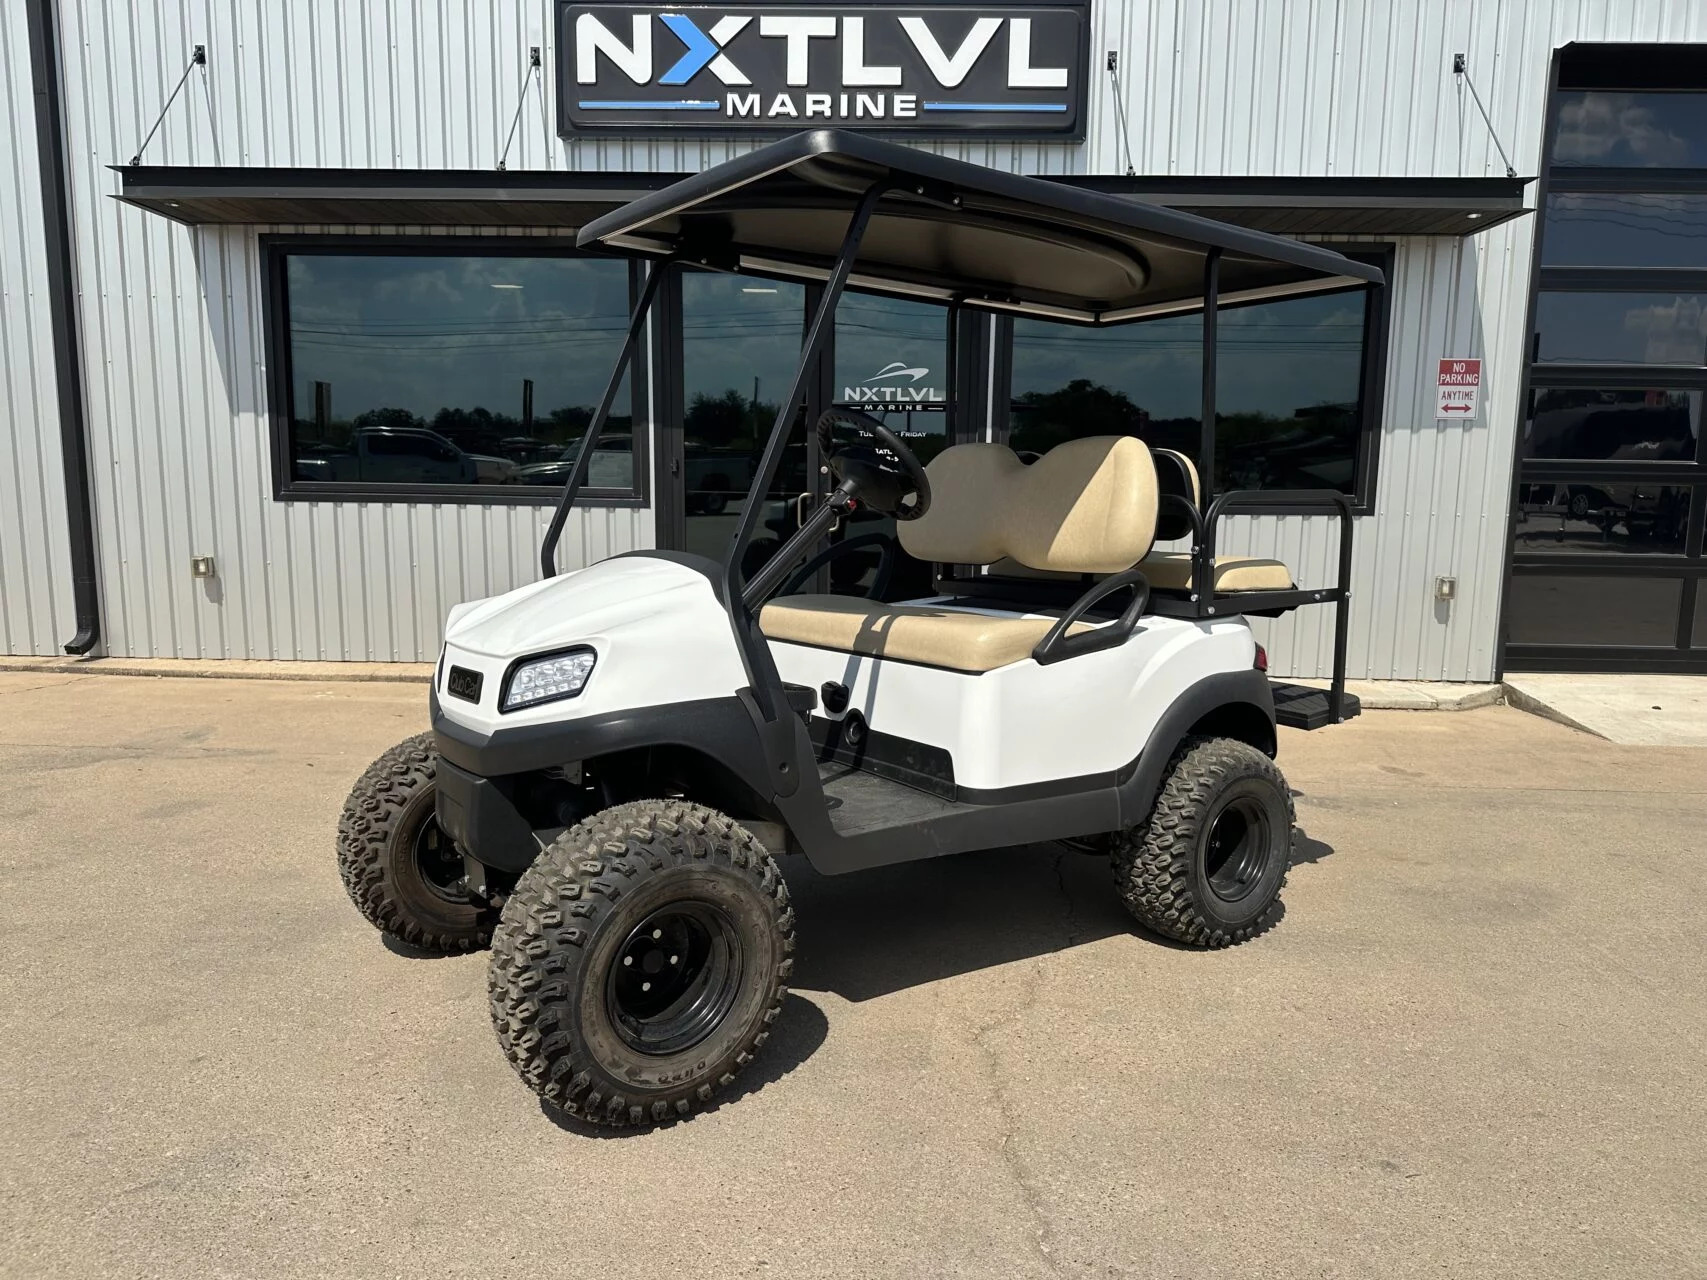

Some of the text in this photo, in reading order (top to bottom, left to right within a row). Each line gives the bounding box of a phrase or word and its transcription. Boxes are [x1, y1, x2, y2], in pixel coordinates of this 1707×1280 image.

[576, 13, 1069, 88] NXTLVL
[725, 92, 918, 118] MARINE
[1453, 362, 1466, 373] NO
[1440, 374, 1479, 384] PARKING
[844, 387, 942, 401] NXTLVL
[1441, 390, 1475, 400] ANYTIME
